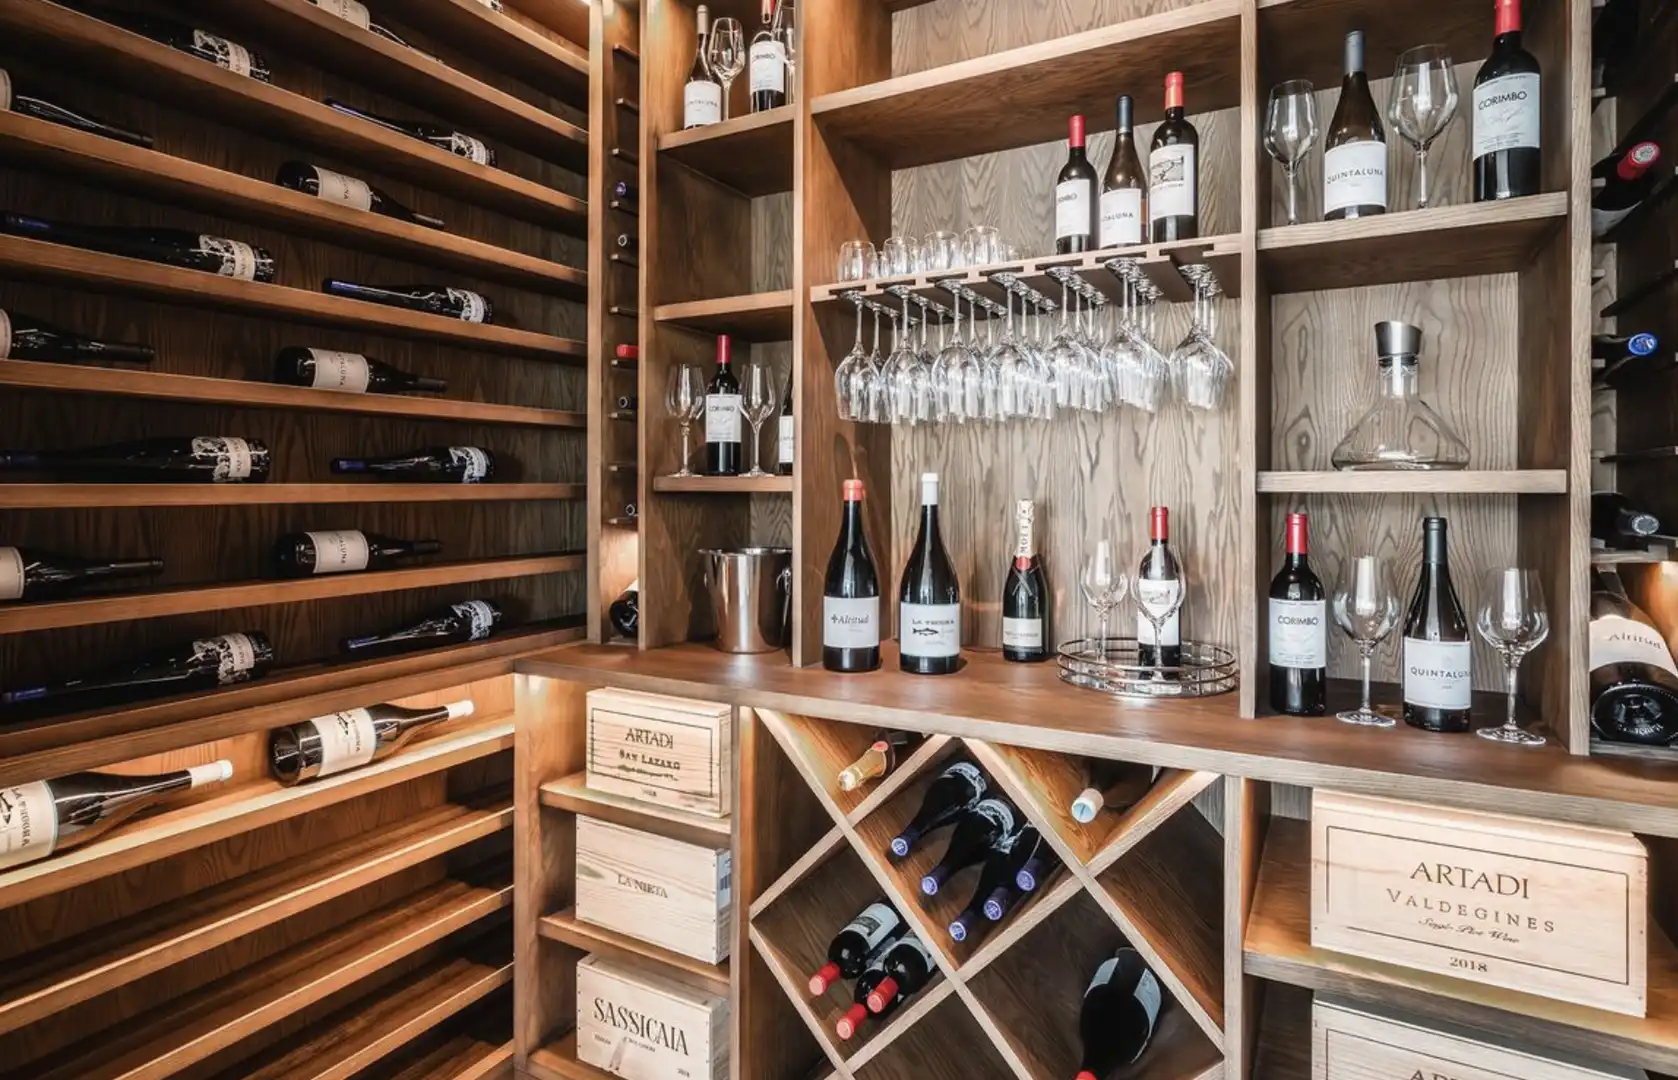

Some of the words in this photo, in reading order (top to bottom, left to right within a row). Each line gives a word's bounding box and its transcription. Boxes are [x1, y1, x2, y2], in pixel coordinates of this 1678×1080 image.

[1479, 91, 1527, 110] CORIMBO
[1277, 614, 1320, 627] CORIMBO
[625, 727, 674, 750] ARTADI
[1409, 861, 1530, 900] ARTADI
[1386, 887, 1556, 934] VALDEGINES
[1449, 956, 1488, 974] 2018
[593, 996, 689, 1057] SASSICAIA
